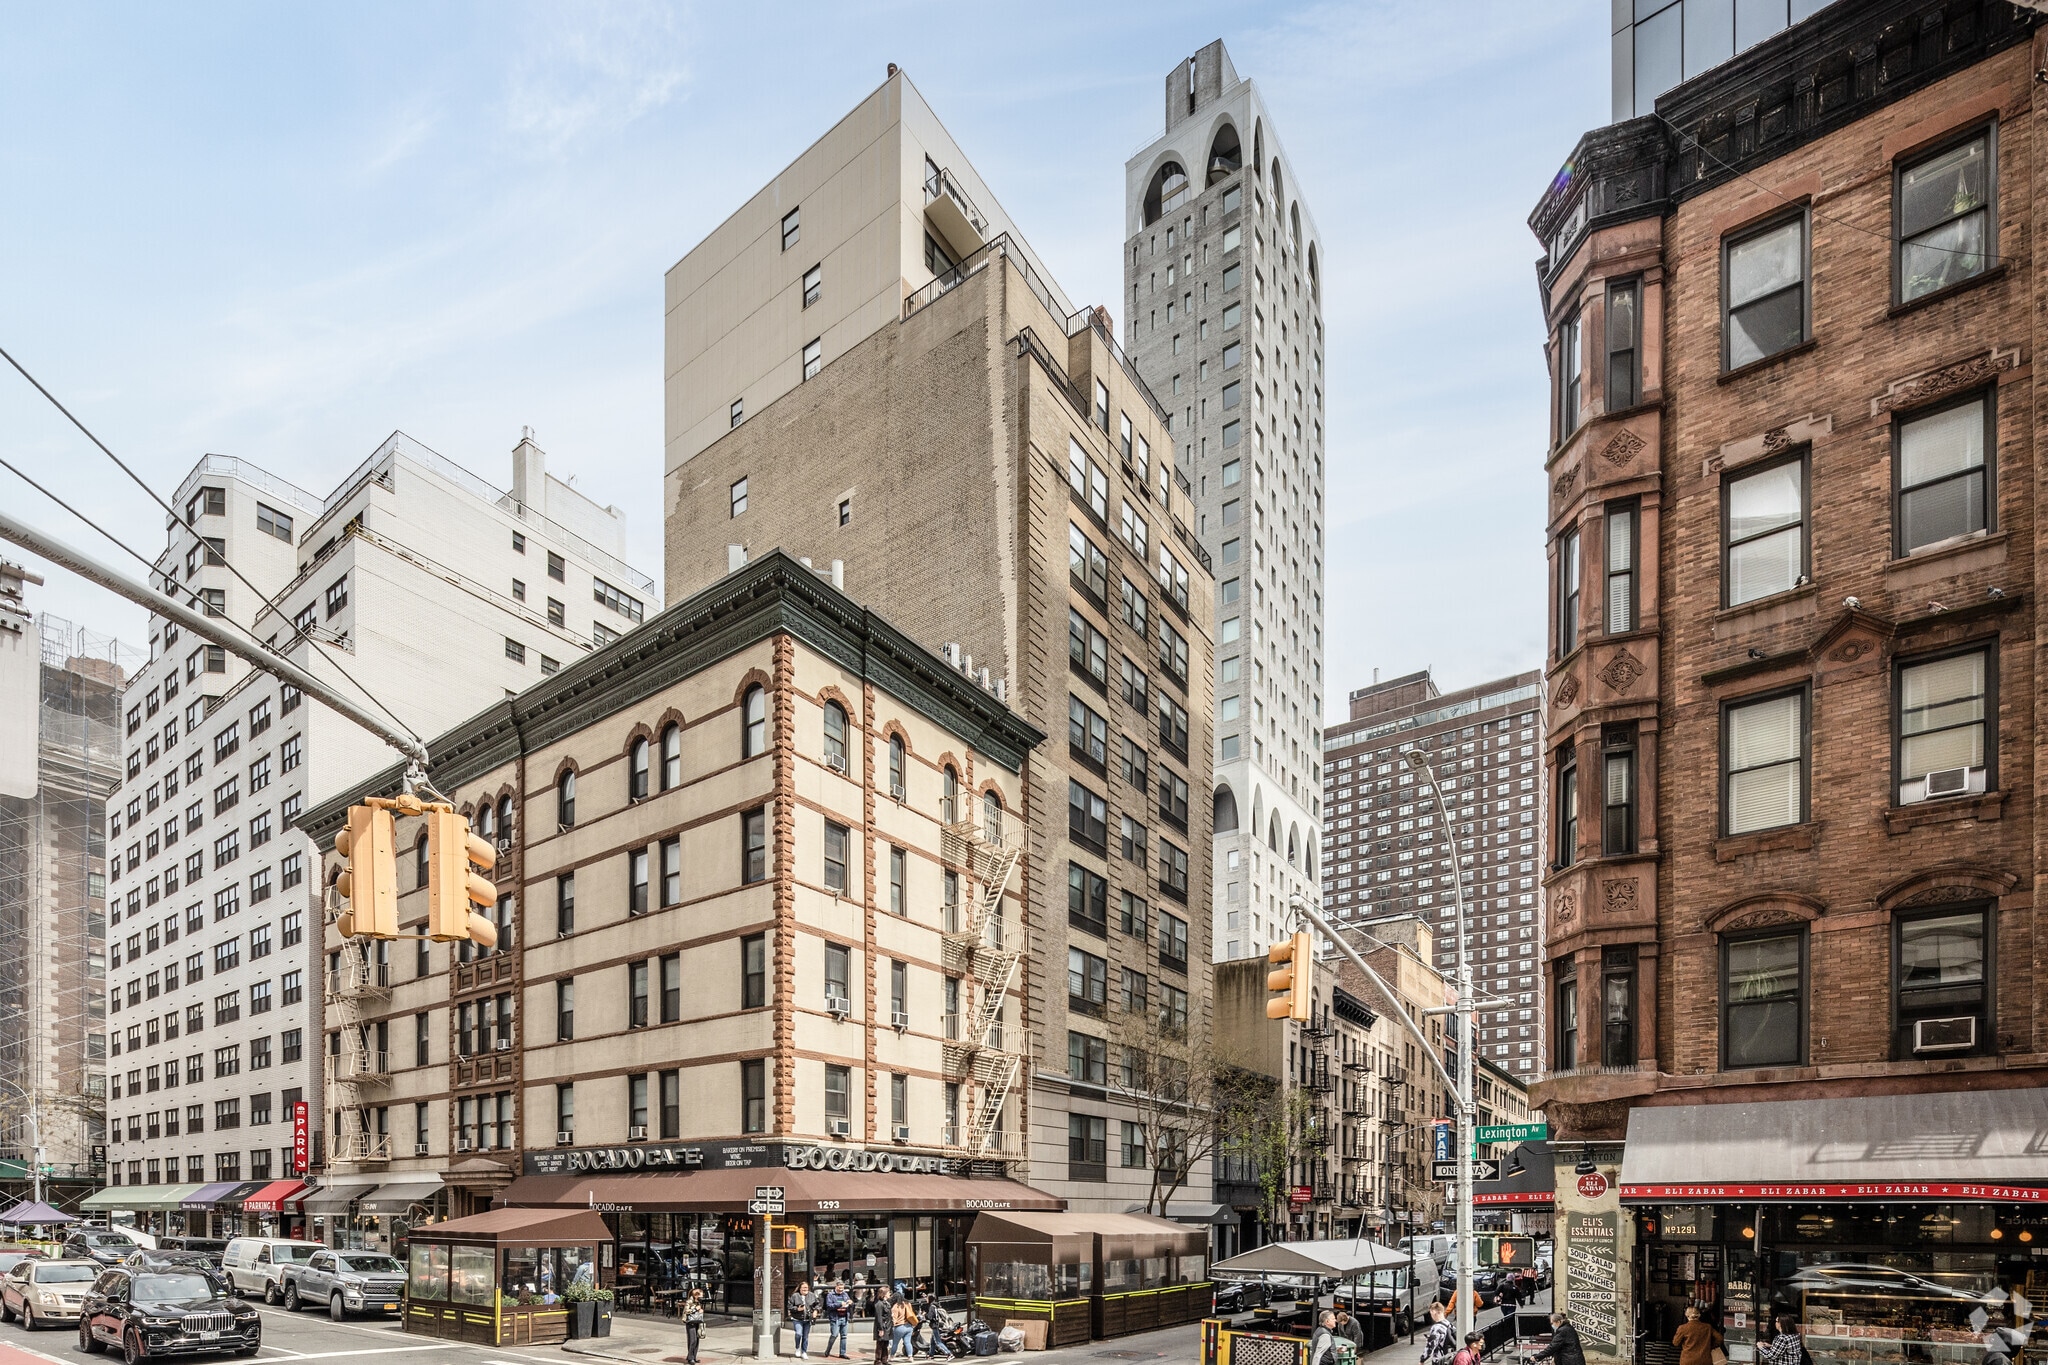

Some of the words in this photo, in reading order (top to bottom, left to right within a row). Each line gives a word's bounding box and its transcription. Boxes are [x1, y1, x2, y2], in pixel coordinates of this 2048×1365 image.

[296, 1118, 306, 1155] PARK
[1480, 1128, 1527, 1140] Lexington
[1531, 1125, 1539, 1133] Av
[567, 1148, 644, 1170] BOCADO
[646, 1148, 700, 1165] CAFE
[787, 1147, 893, 1173] BOCADO
[898, 1155, 951, 1173] CAFE
[1562, 1153, 1616, 1162] LEXGTON
[1962, 1187, 1985, 1195] ELI
[1992, 1188, 2040, 1199] ZABAR
[248, 1201, 271, 1210] PARKING
[592, 1203, 615, 1211] OCADO
[818, 1200, 839, 1209] 1293
[966, 1199, 994, 1208] BOCADO
[1582, 1217, 1603, 1226] ELI'S
[1571, 1227, 1614, 1237] ESSENTIALS
[1570, 1249, 1588, 1260] SOUP
[1591, 1256, 1613, 1269] SALAD
[1570, 1267, 1614, 1289] SANDWICHES
[1728, 1281, 1743, 1290] BAR
[1570, 1291, 1591, 1299] GRAB
[1600, 1292, 1612, 1300] GO
[1569, 1302, 1590, 1315] FRESH
[1590, 1308, 1615, 1325] COFFEE
[1571, 1320, 1611, 1341] BEVERAGES
